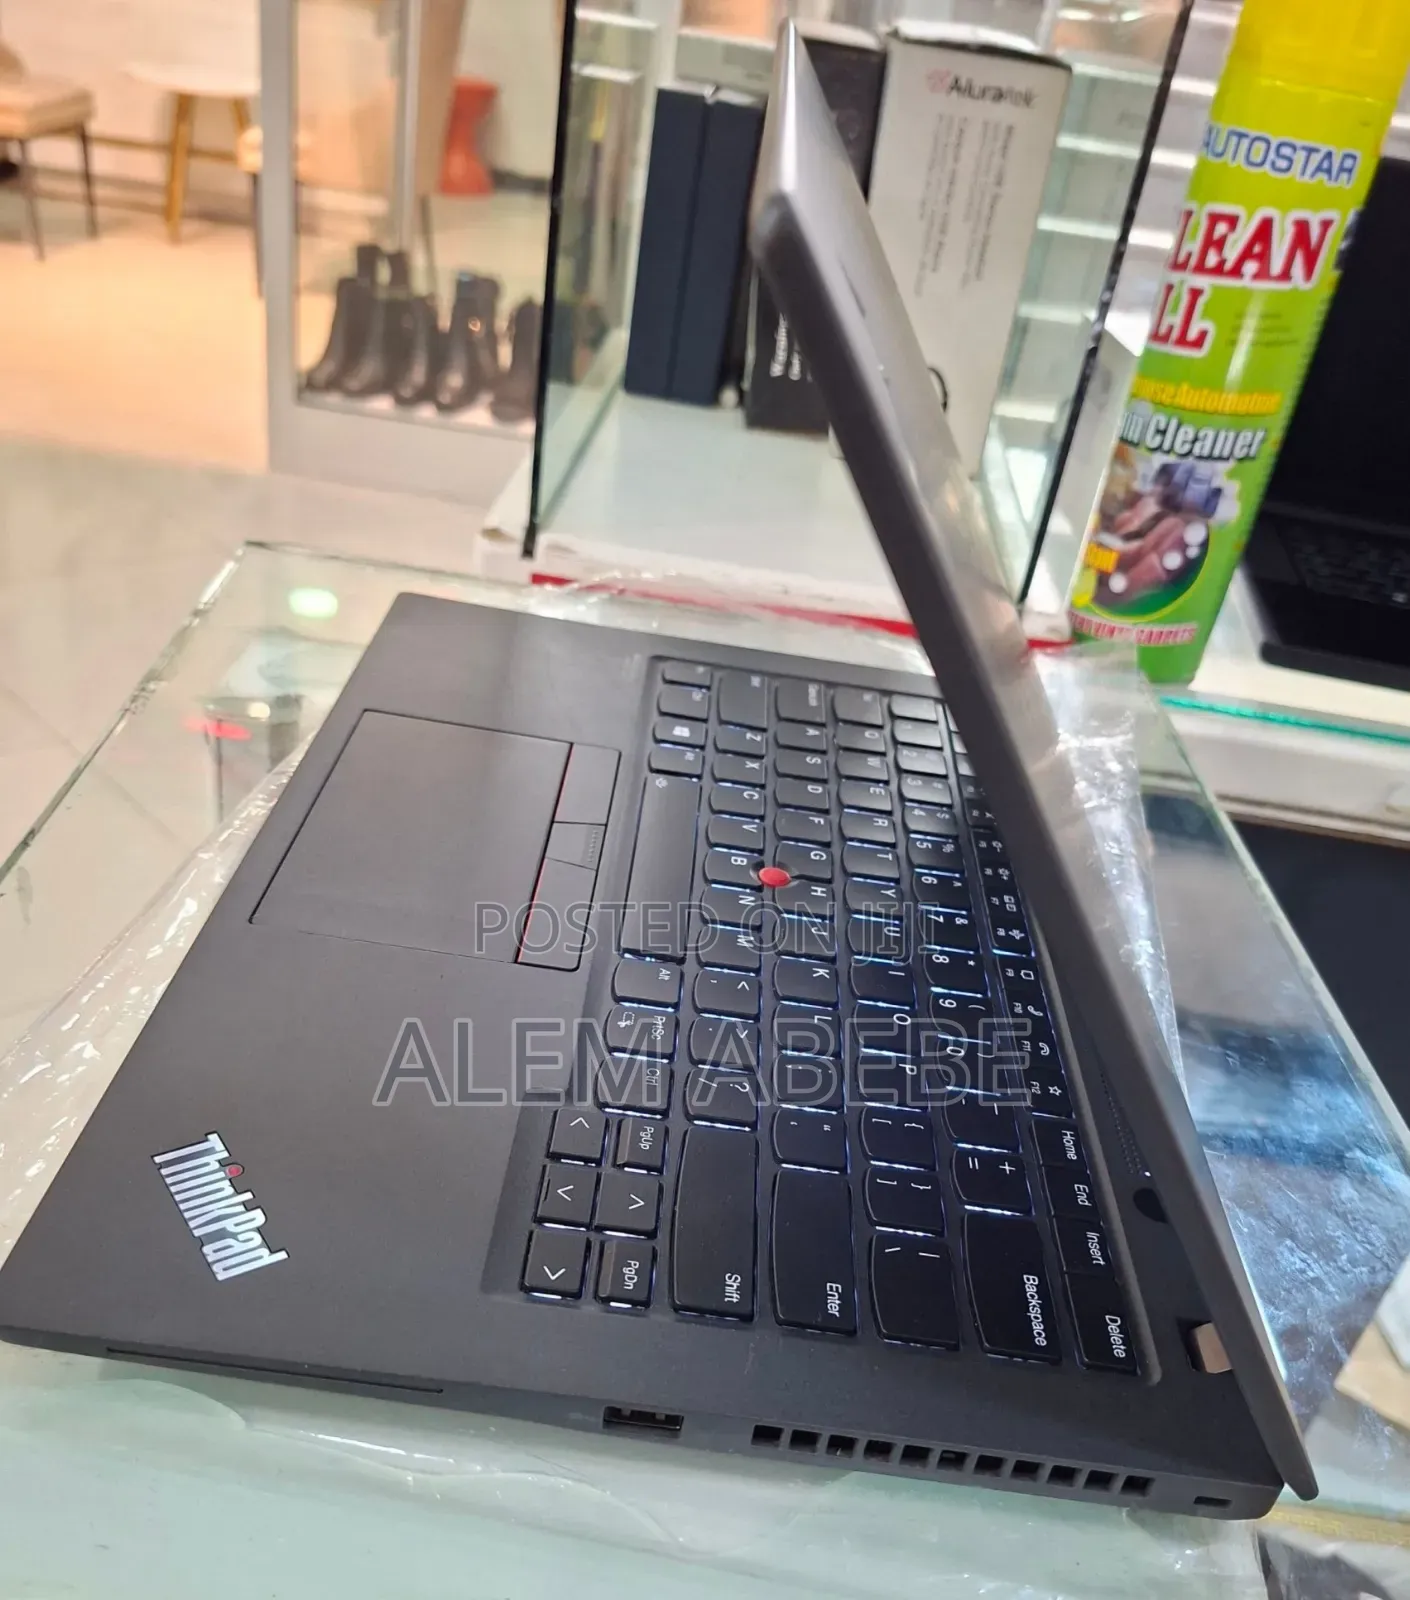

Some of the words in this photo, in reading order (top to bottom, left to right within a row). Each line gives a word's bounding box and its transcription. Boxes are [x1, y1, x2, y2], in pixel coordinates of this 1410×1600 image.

[1145, 411, 1267, 461] Cleaner
[746, 732, 761, 741] Z
[805, 727, 820, 736] A
[745, 761, 760, 769] X
[806, 756, 821, 764] S
[907, 778, 923, 786] 3
[807, 785, 823, 794] D
[870, 787, 885, 795] E
[743, 791, 759, 800] C
[912, 808, 926, 816] 4
[808, 816, 824, 825] F
[873, 818, 888, 827] R
[742, 824, 758, 832] V
[916, 841, 932, 849] 5
[810, 850, 826, 860] G
[731, 856, 747, 866] B
[921, 875, 938, 885] 6
[810, 886, 827, 897] H
[880, 888, 897, 898] Y
[738, 895, 755, 906] N
[928, 914, 944, 923] 7
[811, 927, 828, 936] J
[884, 926, 901, 937] U
[736, 935, 755, 948] M
[932, 954, 949, 964] 8
[658, 967, 671, 981] Alt
[812, 967, 830, 979] K
[939, 998, 957, 1008] 9
[814, 1015, 832, 1024] L
[893, 1013, 911, 1025] O
[1021, 1040, 1032, 1052] F11
[898, 1064, 917, 1075] P
[1030, 1080, 1042, 1095] F12
[639, 1125, 654, 1150] PgUp
[1061, 1130, 1078, 1161] Home
[1074, 1183, 1093, 1207] End
[151, 1132, 290, 1282] ThinkPad
[1085, 1231, 1106, 1266] Insert
[622, 1259, 639, 1290] PgDn
[724, 1272, 741, 1303] Shift
[826, 1282, 842, 1318] Enter
[1022, 1274, 1048, 1347] Backspace
[1104, 1314, 1127, 1359] Delete
